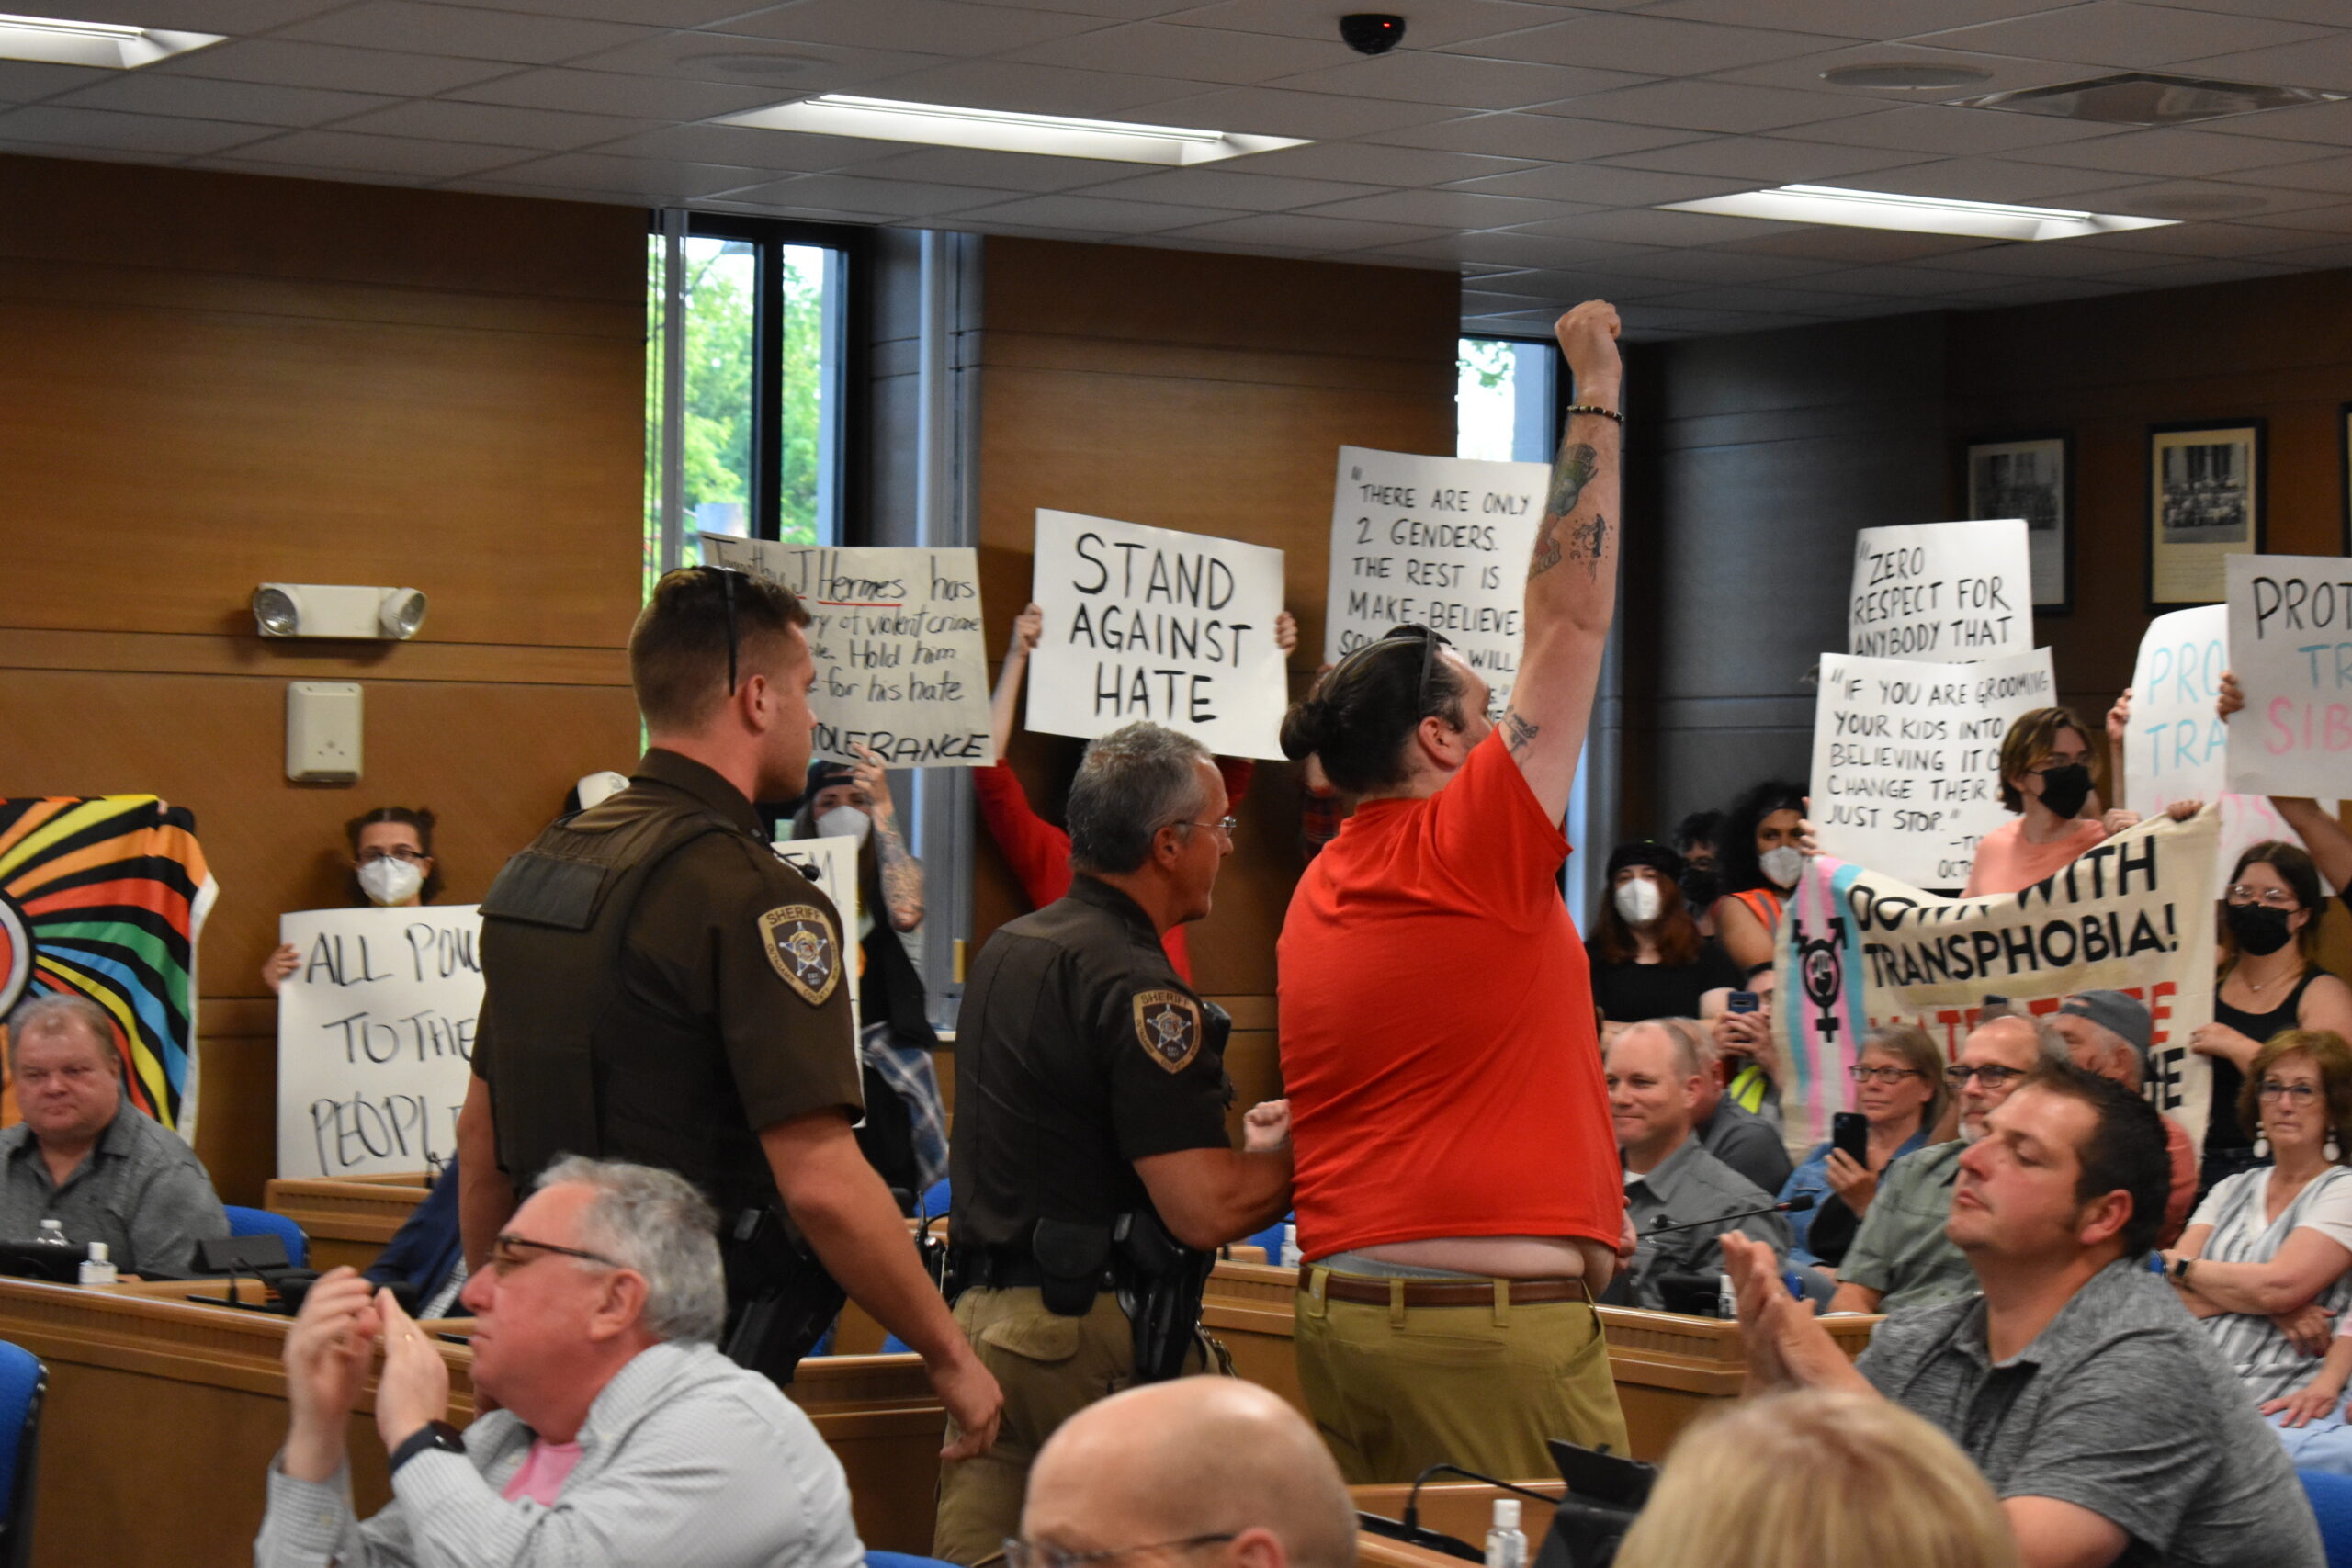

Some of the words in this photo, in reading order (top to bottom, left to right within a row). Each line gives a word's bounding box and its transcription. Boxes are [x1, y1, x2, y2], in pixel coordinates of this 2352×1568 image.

[1431, 489, 1470, 512] ARE
[1482, 492, 1531, 515] ONLY
[1356, 517, 1373, 545] 2
[817, 550, 907, 602] Hermes
[930, 555, 975, 600] has
[1072, 533, 1234, 610] STAND
[1353, 557, 1394, 578] THE
[1406, 558, 1465, 588] REST
[1481, 566, 1501, 589] IS
[1853, 581, 1942, 626] RESPECT
[1957, 575, 2011, 611] FOR
[839, 606, 860, 635] of
[866, 604, 929, 637] violent
[926, 614, 981, 634] crime
[1069, 602, 1253, 668] AGAINST
[1855, 621, 1941, 658] ANYBODY
[1951, 615, 2013, 646] THAT
[849, 639, 901, 669] Hold
[912, 640, 956, 664] him
[1469, 649, 1515, 672] WILL
[822, 665, 860, 698] for
[867, 674, 903, 702] his
[909, 670, 964, 702] hate
[1094, 661, 1218, 723] HATE
[1878, 680, 1921, 705] YOU
[1928, 682, 1967, 707] ARE
[1975, 671, 2048, 708] GROOMING
[1834, 710, 1892, 739] YOUR
[1901, 717, 1948, 741] KIDS
[1959, 717, 2004, 740] INTO
[1830, 743, 1944, 772] BELIEVING
[1961, 748, 1984, 773] IT
[1826, 774, 1913, 800] CHANGE
[1824, 804, 1880, 828] JUST
[766, 907, 820, 925] SHERIFF
[305, 931, 393, 987] ALL
[1864, 903, 2179, 987] TRANSPHOBIA!
[1140, 992, 1187, 1006] SHERIFF
[321, 1010, 400, 1063] TO
[398, 1009, 475, 1062] THE
